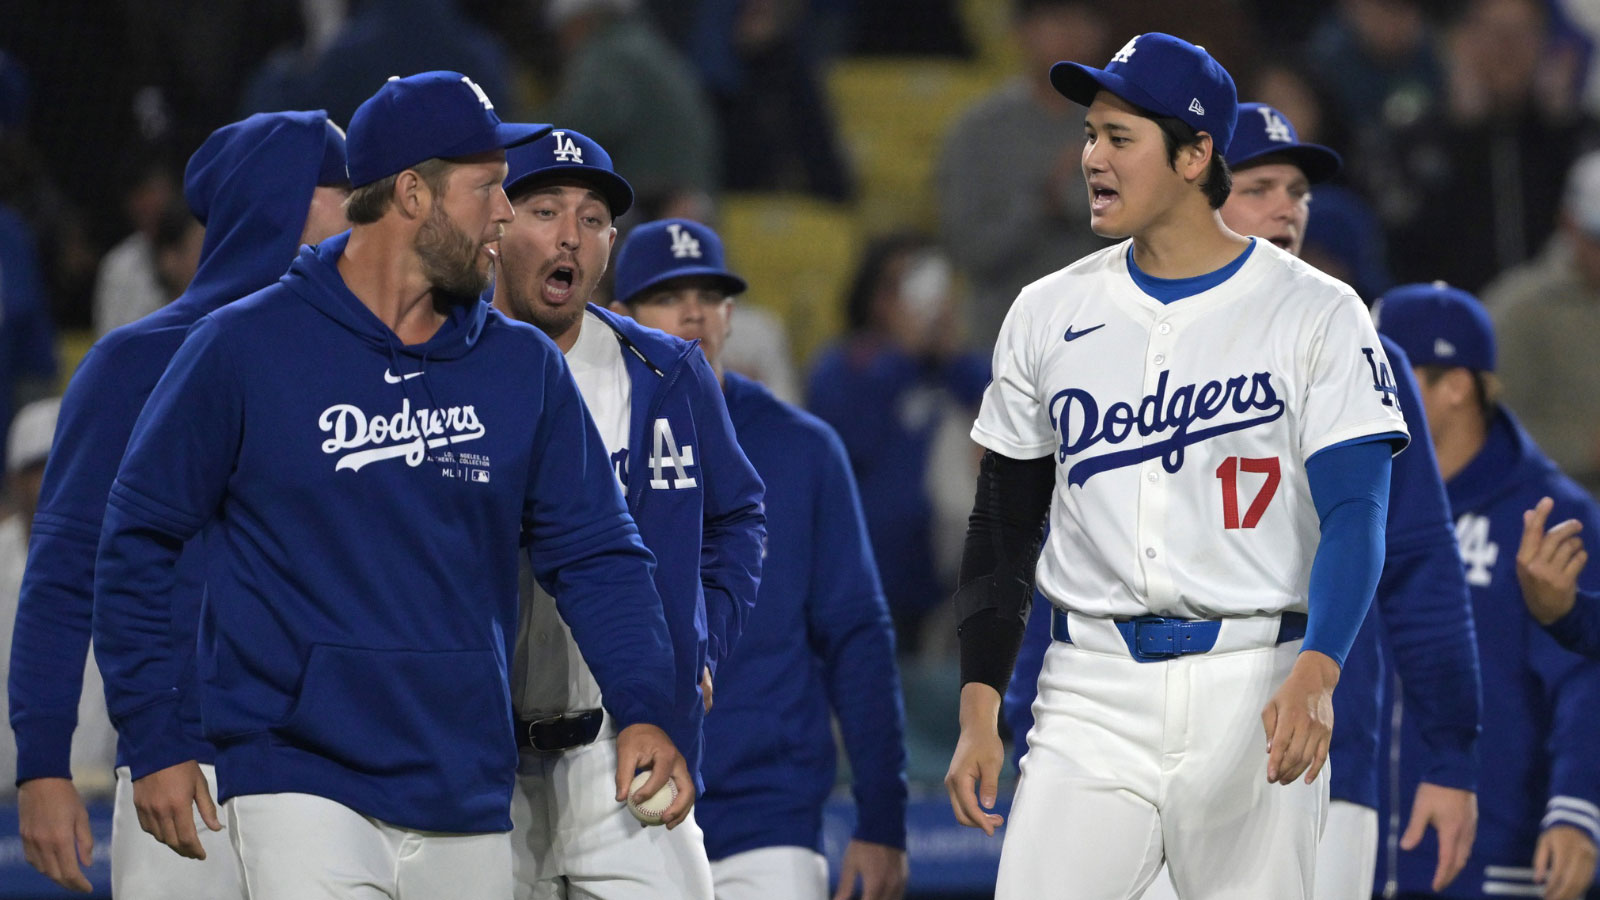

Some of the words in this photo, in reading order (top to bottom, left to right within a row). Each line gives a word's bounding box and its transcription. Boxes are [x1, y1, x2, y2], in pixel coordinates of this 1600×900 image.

[1257, 107, 1292, 142] LA
[552, 131, 583, 163] LA
[666, 224, 702, 258] LA
[318, 398, 486, 473] Dodgers
[1049, 369, 1285, 490] Dodgers
[459, 453, 480, 461] NGELES,
[1216, 456, 1282, 530] 17
